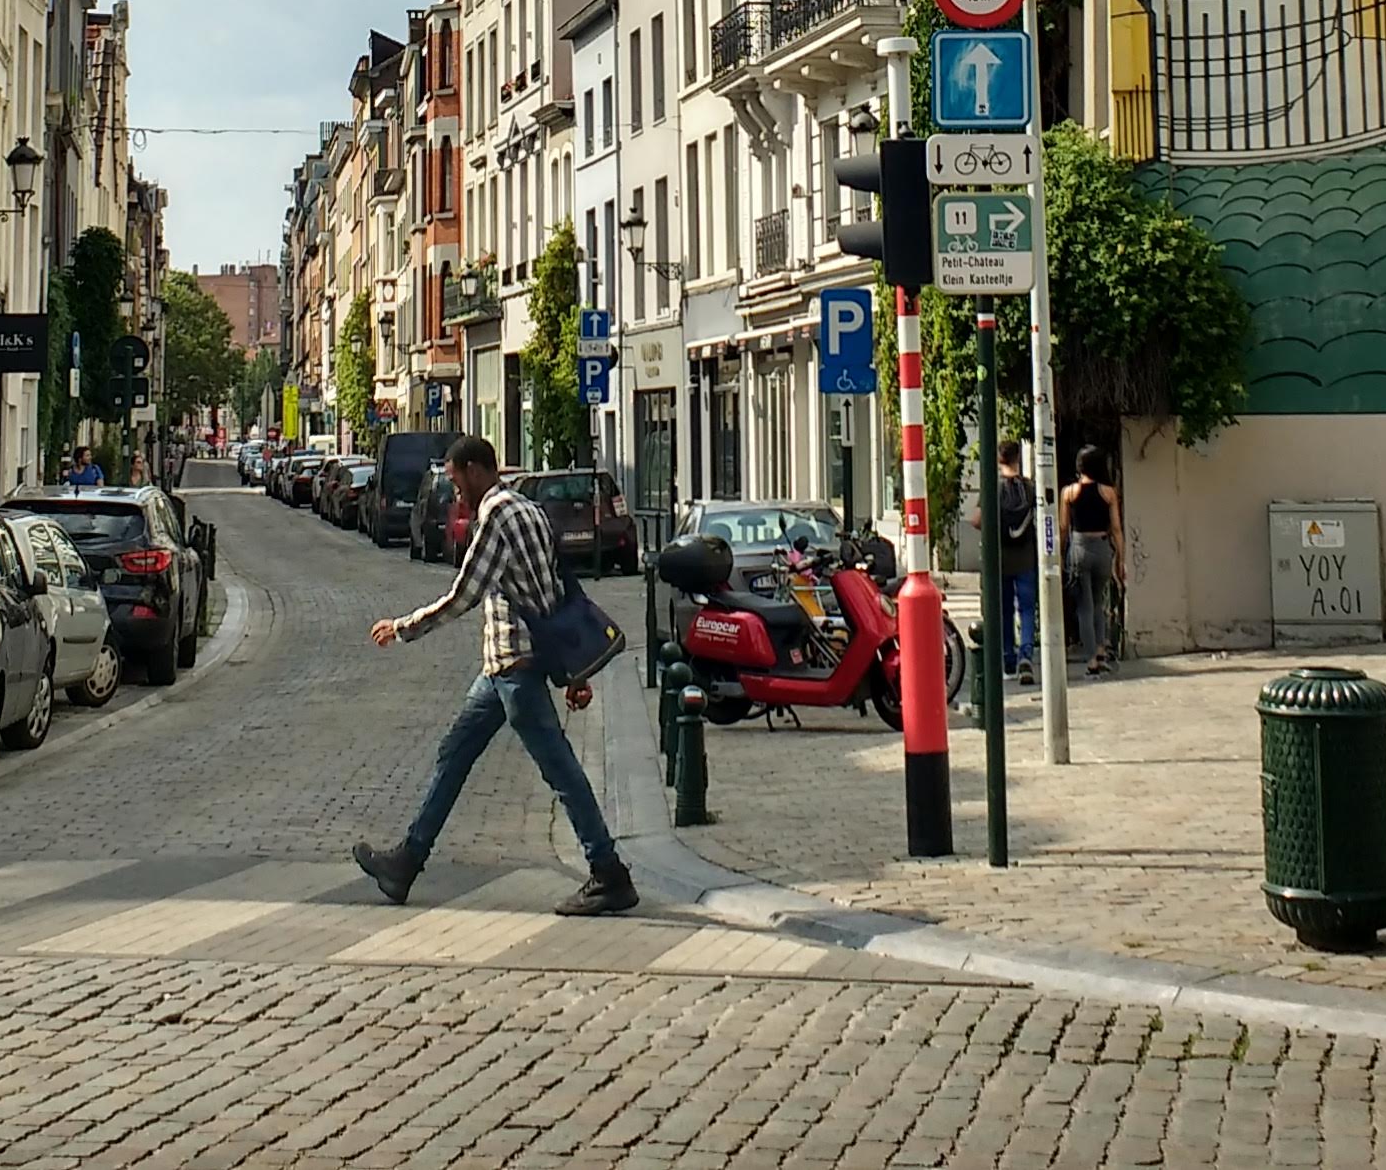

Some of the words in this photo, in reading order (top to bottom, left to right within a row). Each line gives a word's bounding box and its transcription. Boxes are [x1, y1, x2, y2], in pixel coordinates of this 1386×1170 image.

[955, 211, 967, 225] 11
[942, 273, 964, 285] Klein
[969, 273, 1013, 287] Kasteeltje
[828, 300, 865, 356] P
[585, 360, 603, 386] P
[696, 616, 740, 634] Europcar
